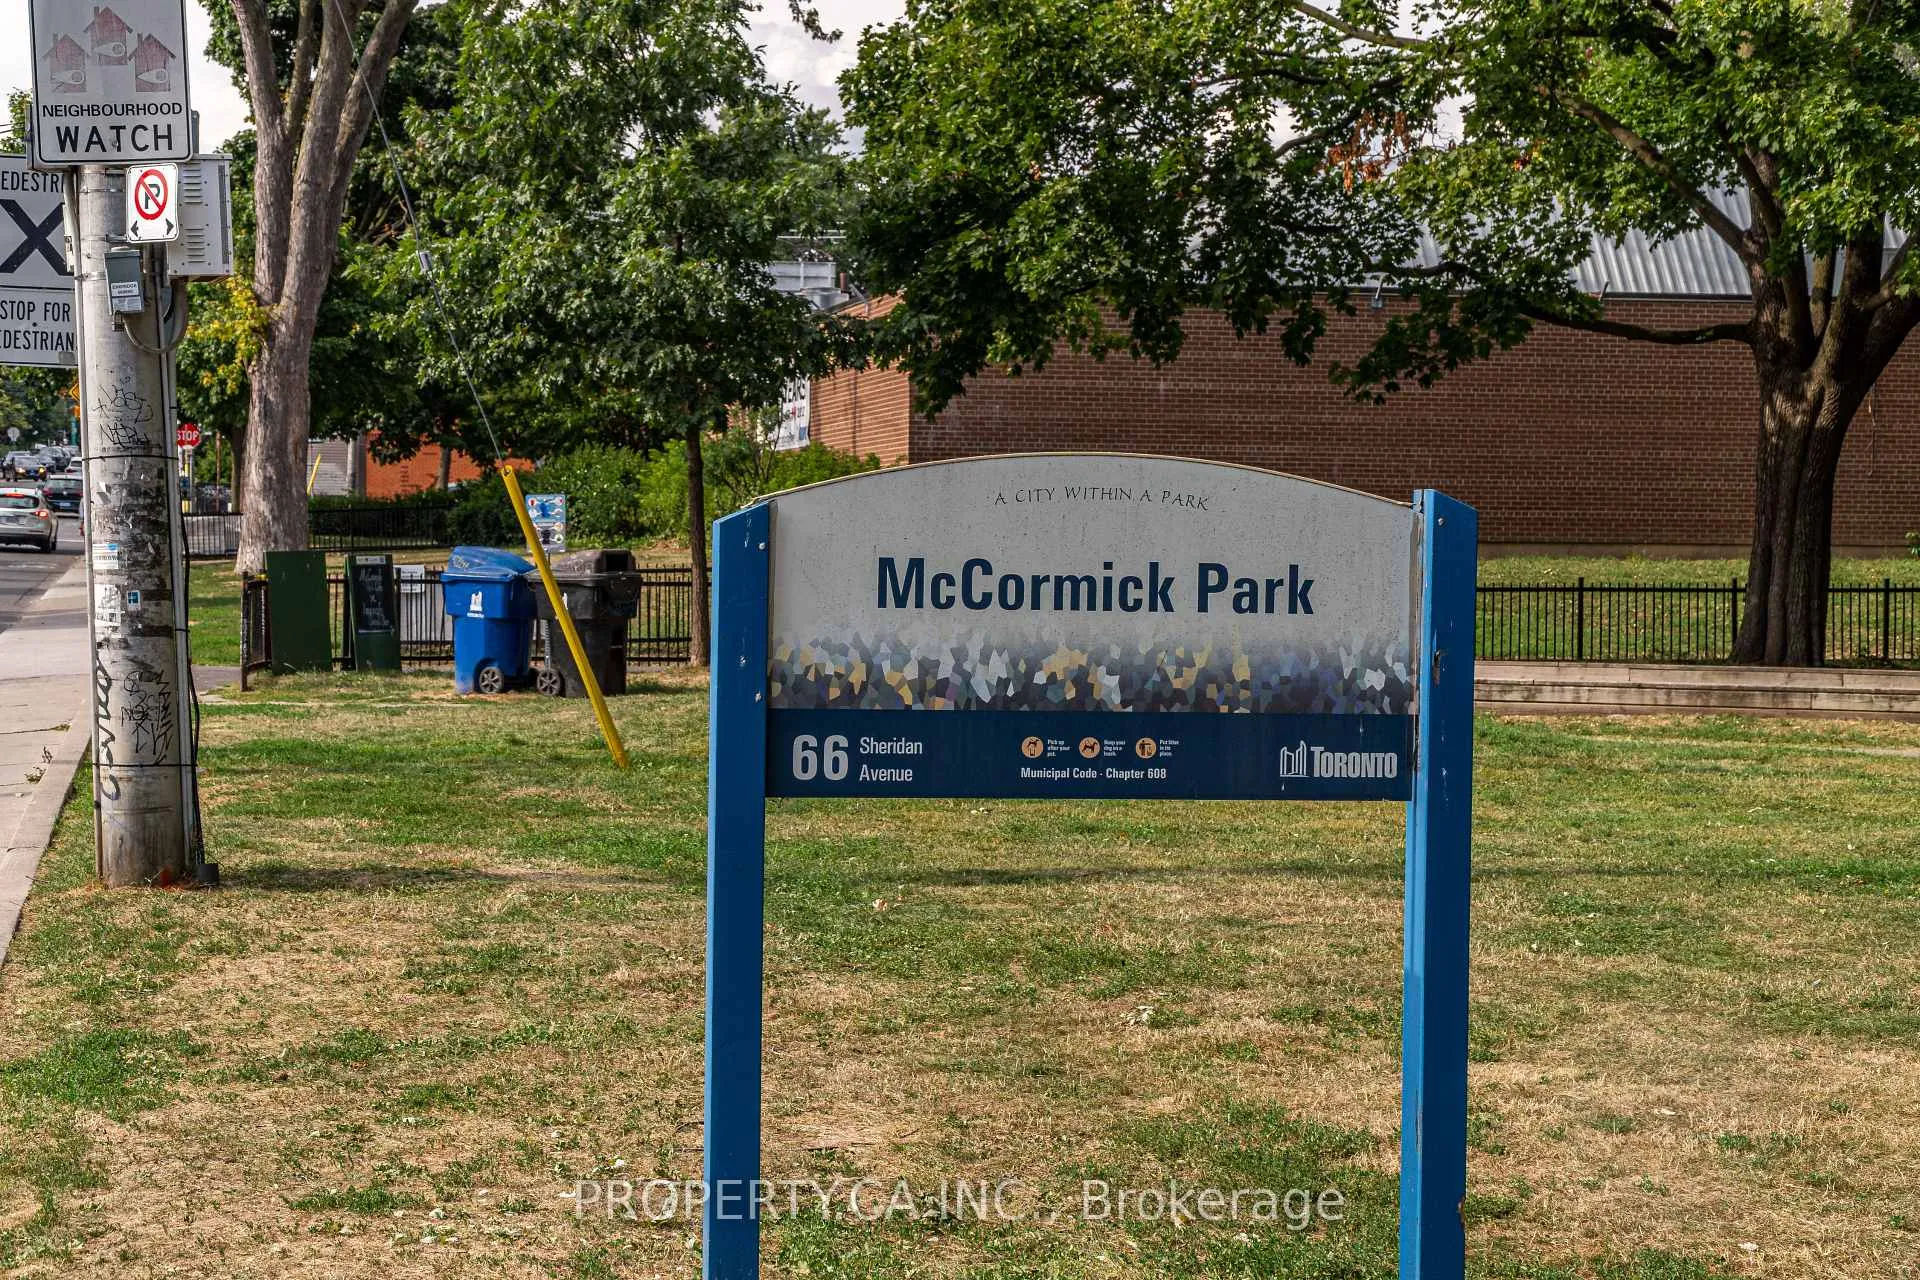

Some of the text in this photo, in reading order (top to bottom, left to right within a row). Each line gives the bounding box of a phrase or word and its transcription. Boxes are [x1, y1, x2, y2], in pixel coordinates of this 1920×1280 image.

[42, 102, 183, 118] NEIGHBOURHOOD
[55, 123, 173, 153] WATCH
[0, 300, 71, 323] STOP FOR
[177, 430, 199, 441] STOP
[994, 486, 1209, 511] A CITY WITHIN A PARK
[877, 556, 1315, 616] McCormick Park
[859, 736, 923, 755] Sheridan
[792, 734, 849, 781] 66
[1310, 746, 1398, 779] TORONTO
[859, 764, 913, 782] Avenue
[1020, 767, 1070, 782] Municipal
[1072, 768, 1097, 779] Code
[1105, 768, 1144, 781] Chapter
[1147, 768, 1167, 779] 608
